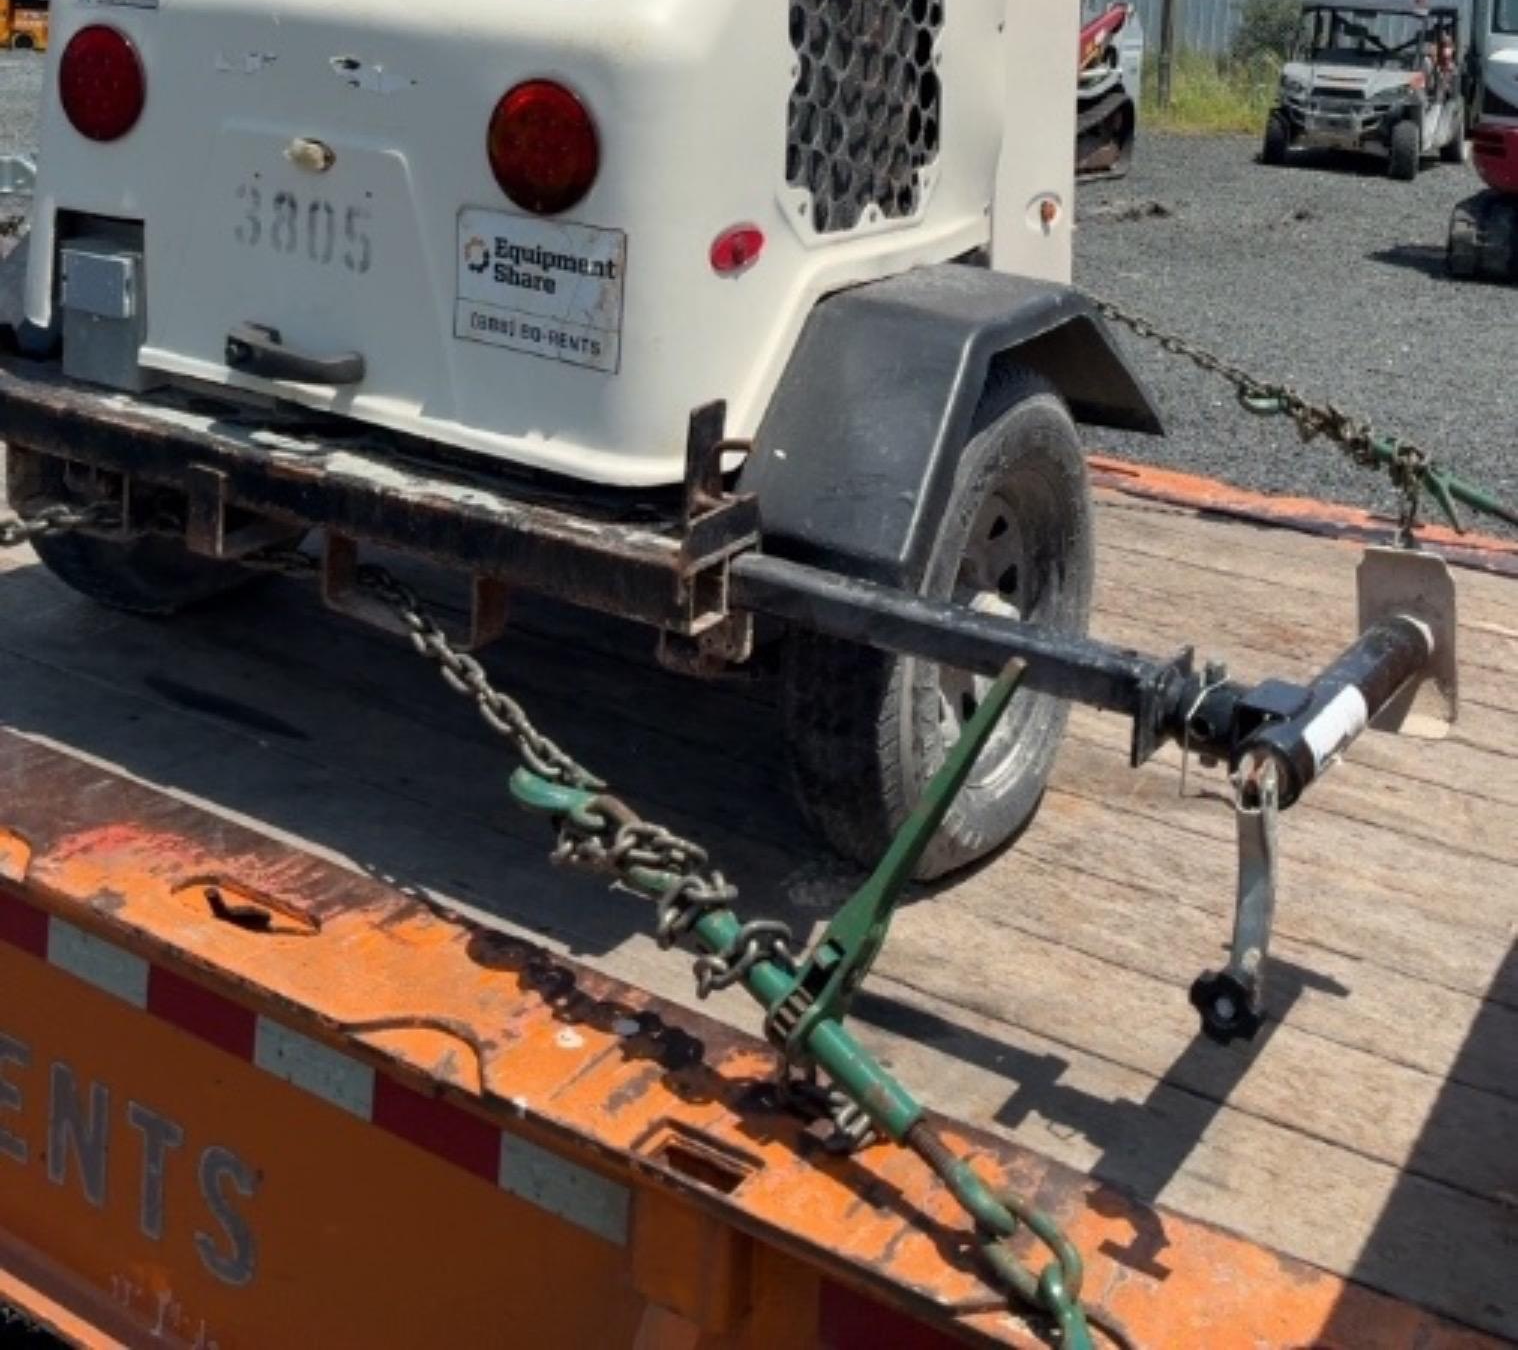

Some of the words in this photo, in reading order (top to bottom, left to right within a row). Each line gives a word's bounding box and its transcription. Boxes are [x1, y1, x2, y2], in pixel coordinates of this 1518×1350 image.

[234, 185, 373, 274] 3805
[494, 236, 617, 280] Equipment
[494, 263, 556, 295] Share
[521, 323, 601, 356] EQ-RENTS
